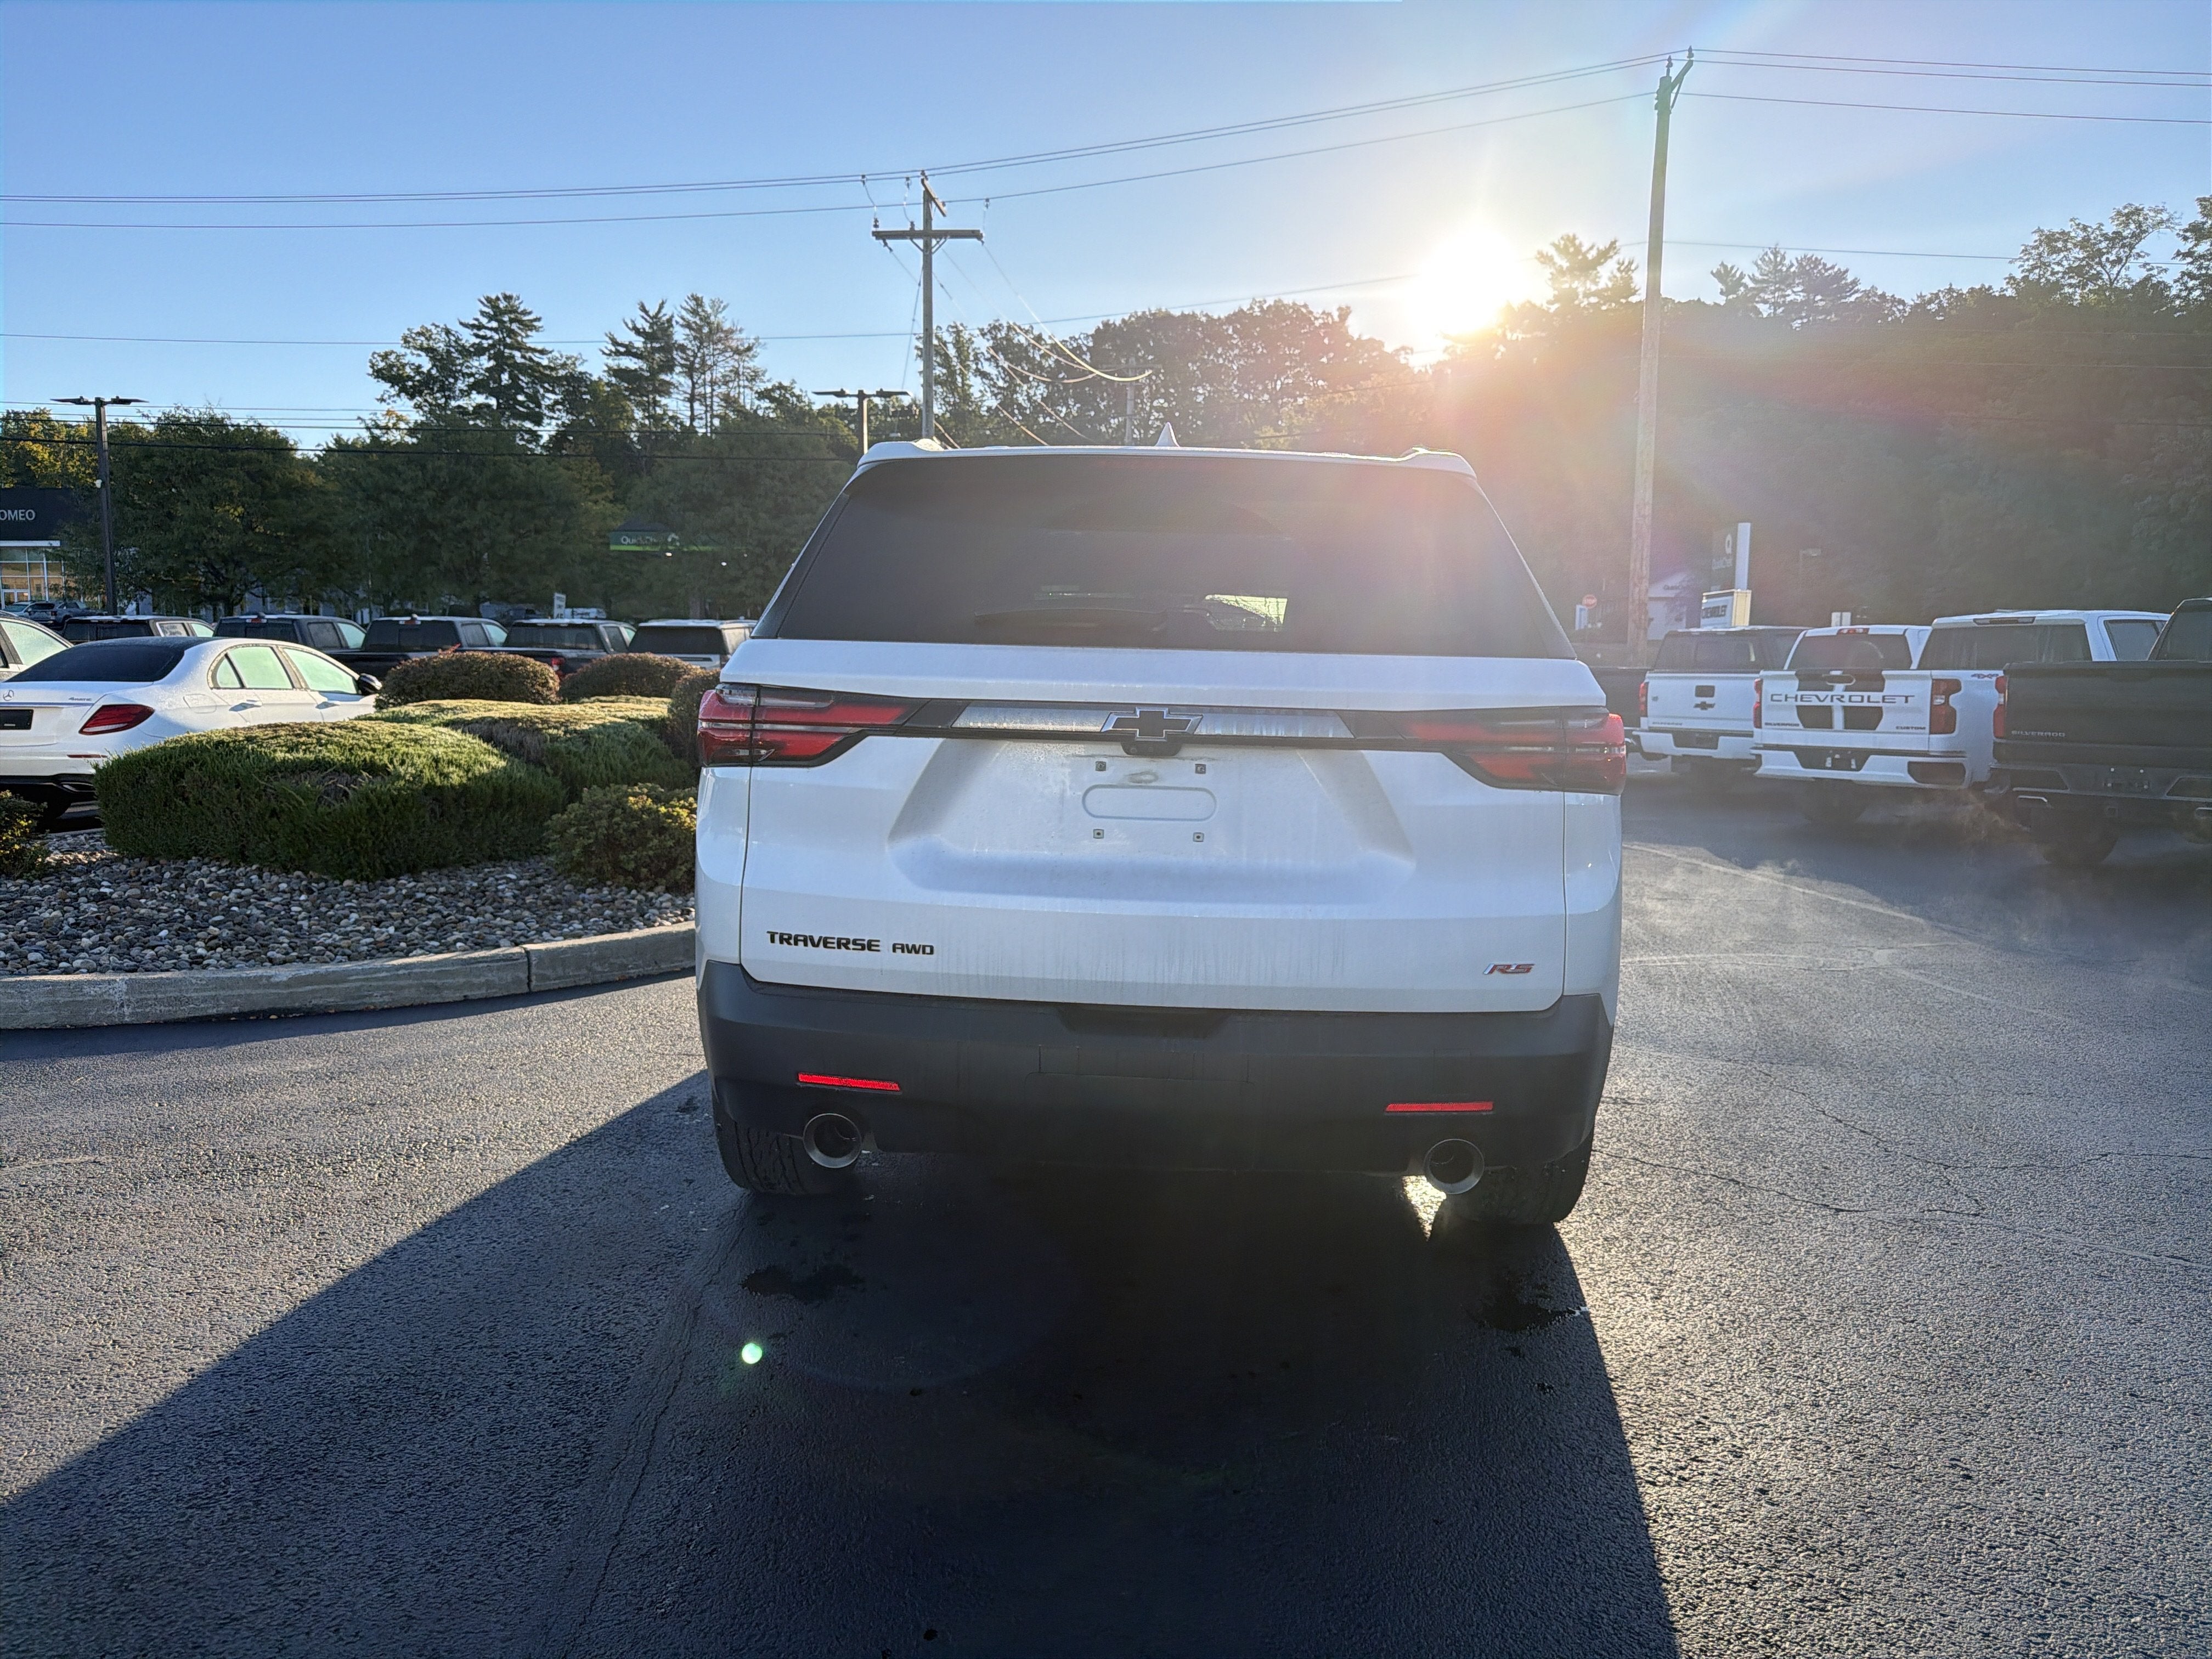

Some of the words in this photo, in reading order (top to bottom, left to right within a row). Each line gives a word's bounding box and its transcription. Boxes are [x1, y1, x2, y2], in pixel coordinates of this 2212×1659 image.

[1770, 693, 1915, 704] CHEVROLET
[766, 930, 881, 952] TRAVERSE
[892, 943, 934, 955] AWD
[1483, 963, 1536, 974] RS
